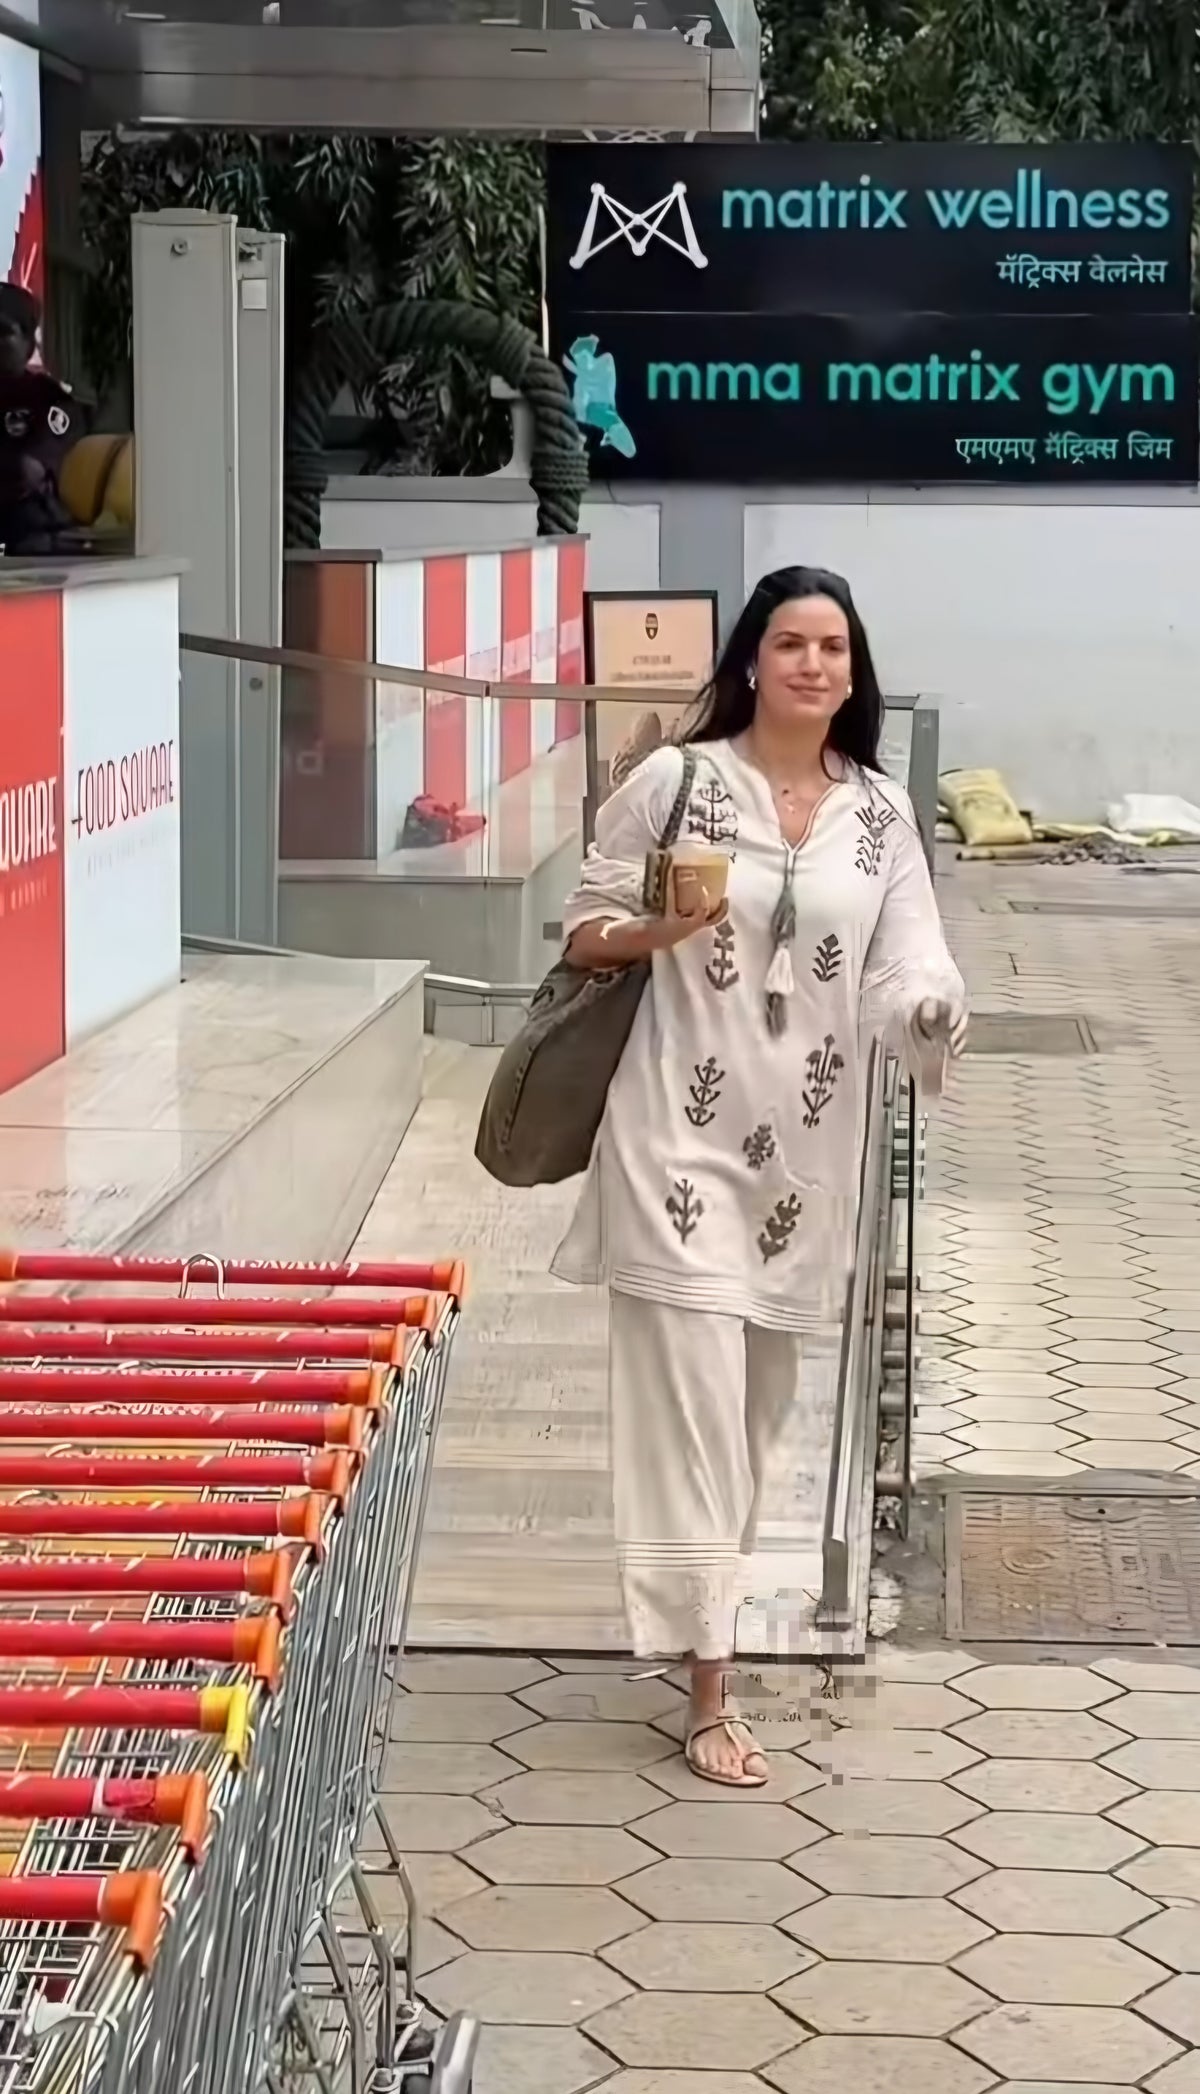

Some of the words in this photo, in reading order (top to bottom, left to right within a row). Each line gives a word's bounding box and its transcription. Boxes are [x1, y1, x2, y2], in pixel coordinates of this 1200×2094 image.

[722, 174, 908, 229] matrix
[925, 167, 1170, 229] wellness
[1088, 253, 1169, 284] वेलनेस
[648, 362, 800, 401] mma
[828, 349, 1020, 401] matrix
[1042, 363, 1175, 415] gym
[955, 438, 1036, 465] एमएमए
[1127, 430, 1174, 460] जिम
[71, 759, 116, 840] FOOD
[120, 739, 174, 822] SQUARE
[0, 776, 58, 873] QUARE
